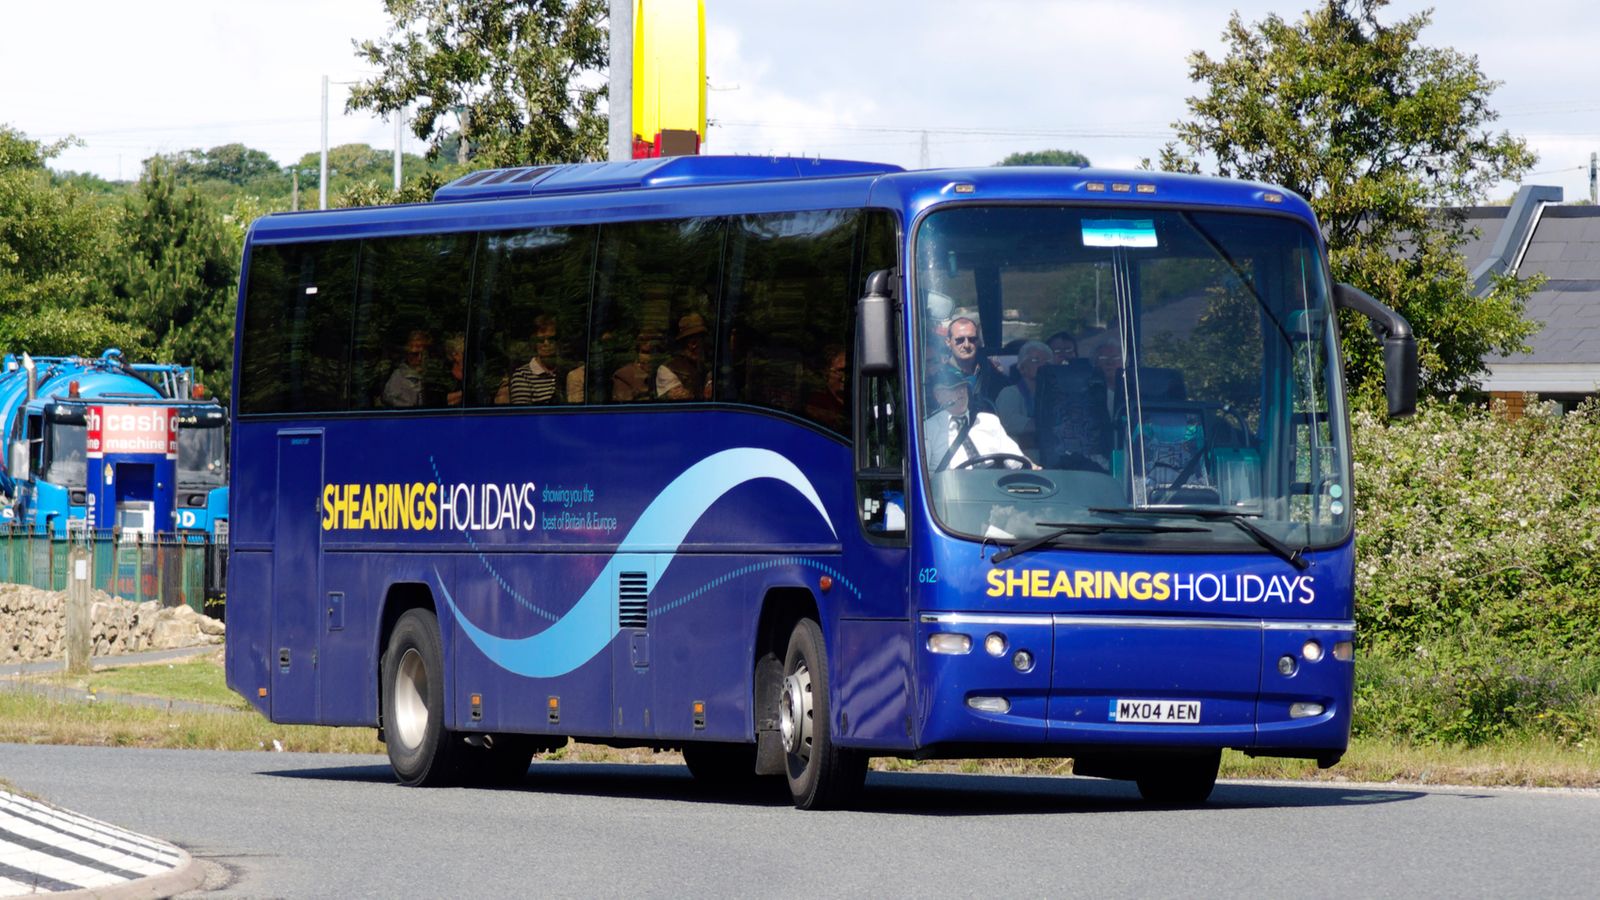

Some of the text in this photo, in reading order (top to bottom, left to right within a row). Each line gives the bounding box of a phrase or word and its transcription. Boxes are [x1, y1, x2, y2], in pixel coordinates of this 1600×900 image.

[107, 408, 165, 432] cash
[106, 436, 165, 450] machine
[322, 481, 536, 531] SHEARINGS HOLIDAYS
[542, 483, 594, 508] showing you the
[542, 511, 617, 535] best of Britain & Europe
[918, 568, 938, 584] 612
[986, 568, 1315, 604] SHEARINGS HOLIDAYS
[1119, 702, 1198, 720] MX04 AEN
